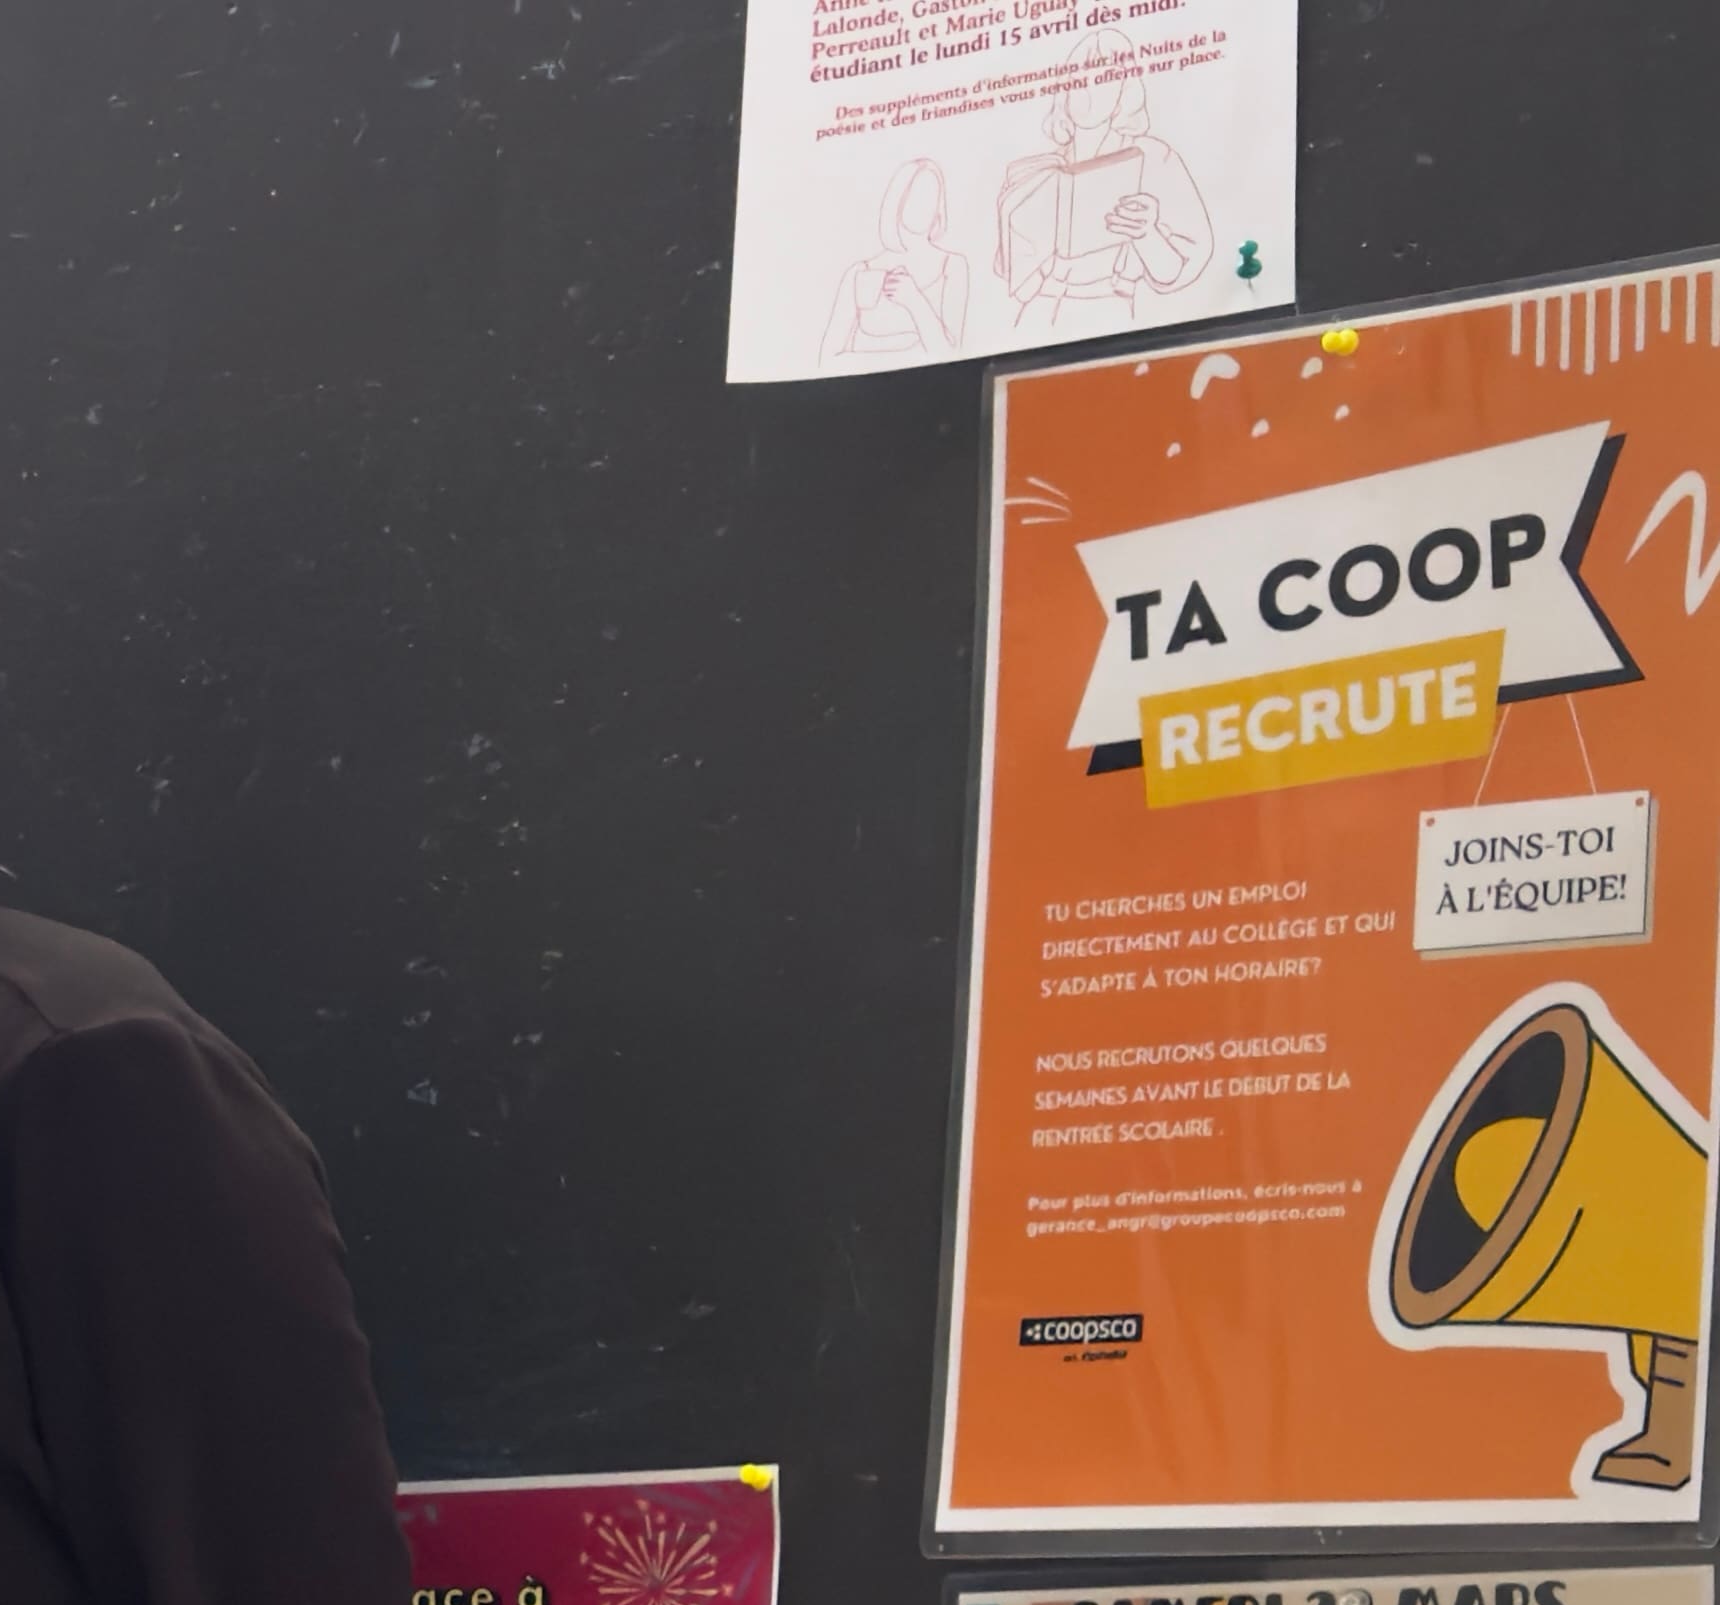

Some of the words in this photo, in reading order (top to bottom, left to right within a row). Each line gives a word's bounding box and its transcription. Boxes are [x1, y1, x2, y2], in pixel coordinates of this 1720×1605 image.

[812, 28, 910, 60] Perreault
[919, 25, 937, 41] et
[946, 8, 1006, 35] Marie
[813, 8, 904, 37] Lalonde,
[810, 54, 903, 83] étudiant
[911, 48, 928, 66] le
[936, 32, 990, 60] lundi
[1000, 27, 1021, 46] 15
[1030, 12, 1078, 40] avril
[1086, 6, 1122, 27] dès
[836, 105, 864, 121] Des
[869, 86, 968, 119] suppléments
[1139, 39, 1183, 59] Nuits
[1188, 34, 1207, 49] de
[1212, 29, 1227, 44] la
[816, 121, 867, 141] poésie
[871, 118, 886, 131] et
[891, 111, 917, 127] des
[1000, 89, 1035, 104] vous
[1149, 60, 1174, 74] sur
[1115, 580, 1228, 661] TA
[1257, 513, 1546, 632] COOP
[1159, 660, 1478, 770] RECRUTE
[1445, 826, 1615, 867] JOINS-TOI
[1044, 902, 1070, 921] TU
[1076, 893, 1185, 921] CHERCHES
[1191, 889, 1224, 910] UN
[1229, 880, 1308, 906] EMPLOI
[1436, 882, 1459, 915] À
[1467, 873, 1627, 912] L'ÉQUIPE!
[1042, 930, 1183, 960] DIRECTEMENT
[1187, 928, 1218, 948] AU
[1324, 915, 1349, 936] ET
[1354, 911, 1397, 933] QUI
[1040, 971, 1137, 999] S'ADAPTE
[1164, 966, 1209, 988] TON
[1214, 957, 1323, 983] HORAIRE?
[1036, 1051, 1092, 1073] NOUS
[1097, 1041, 1215, 1069] RECRUTONS
[1220, 1033, 1328, 1061] QUELQUES
[1034, 1086, 1128, 1111] SEMAINES
[1131, 1080, 1199, 1104] AVANT
[1204, 1078, 1224, 1099] LE
[1296, 1071, 1323, 1092] DE
[1327, 1070, 1352, 1090] LA
[1027, 1197, 1067, 1211] Pour
[1043, 1318, 1137, 1343] coopsco
